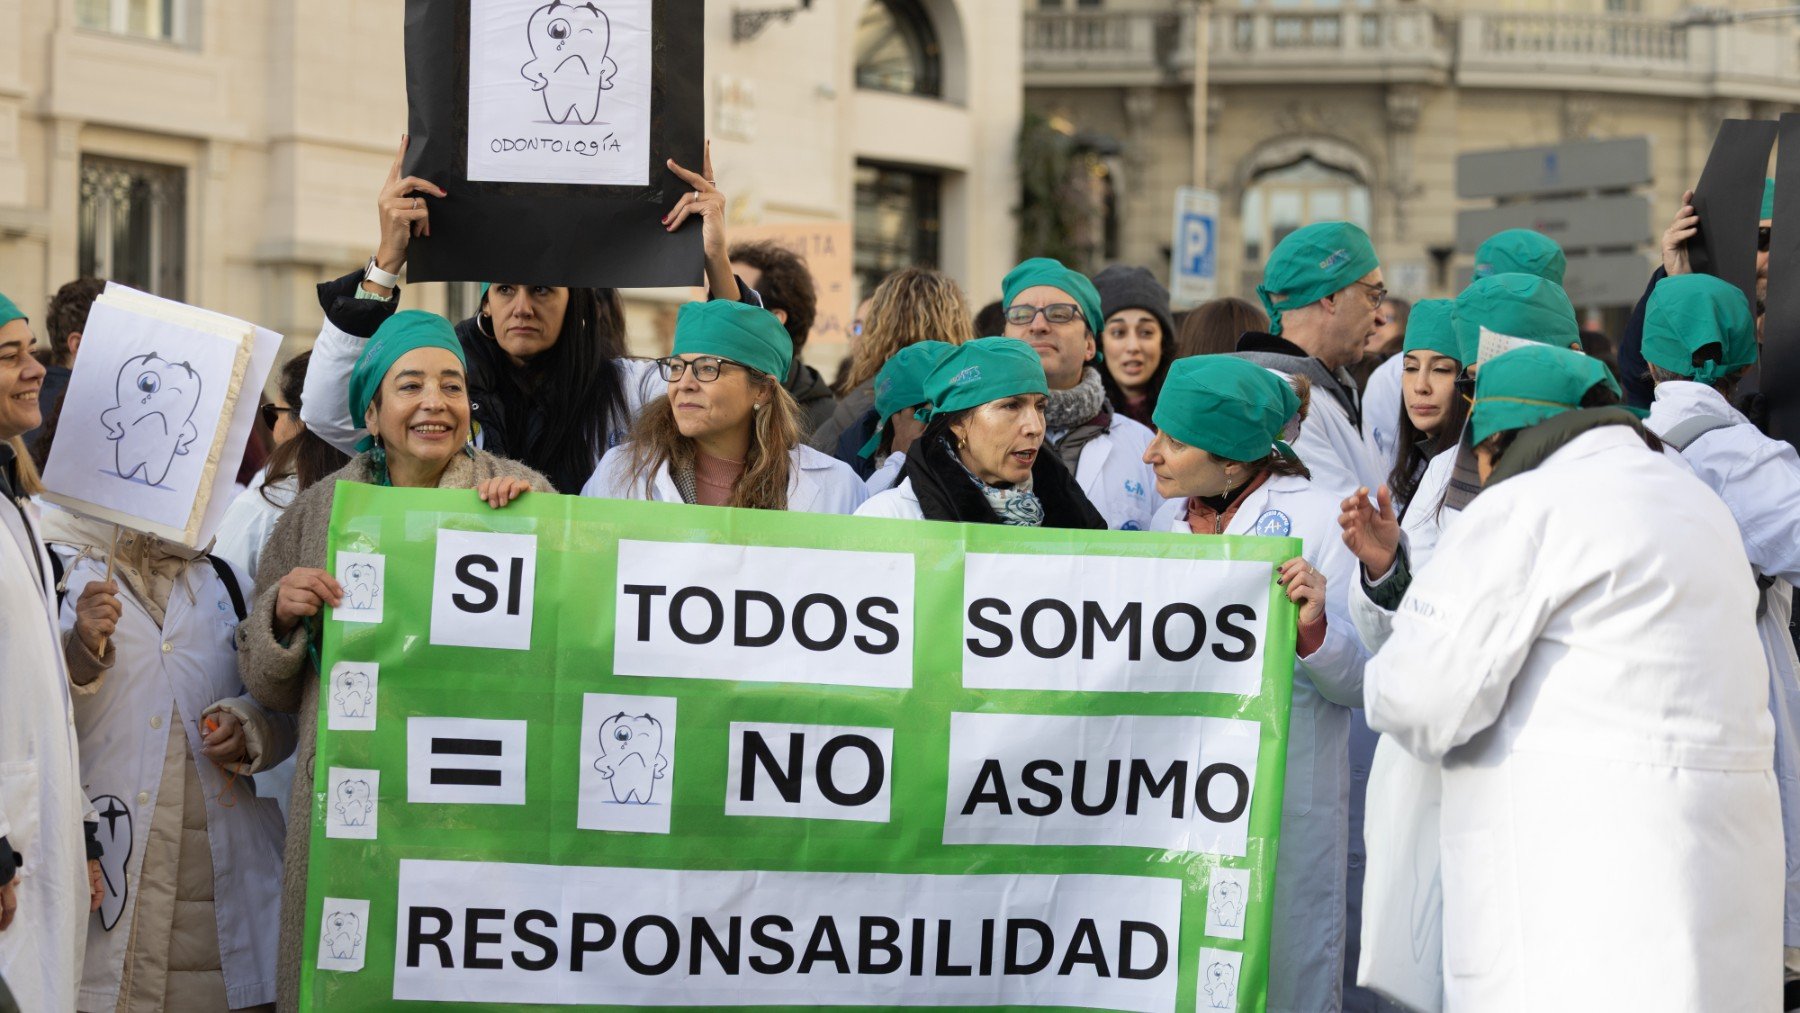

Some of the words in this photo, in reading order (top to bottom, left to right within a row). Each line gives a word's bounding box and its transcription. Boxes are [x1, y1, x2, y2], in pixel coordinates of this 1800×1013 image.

[452, 554, 524, 616] SI
[623, 584, 900, 655] TODOS
[966, 597, 1257, 662] SOMOS
[739, 730, 885, 807] NO
[960, 758, 1249, 823] ASUMO
[406, 906, 1169, 980] RESPONSABILIDAD
